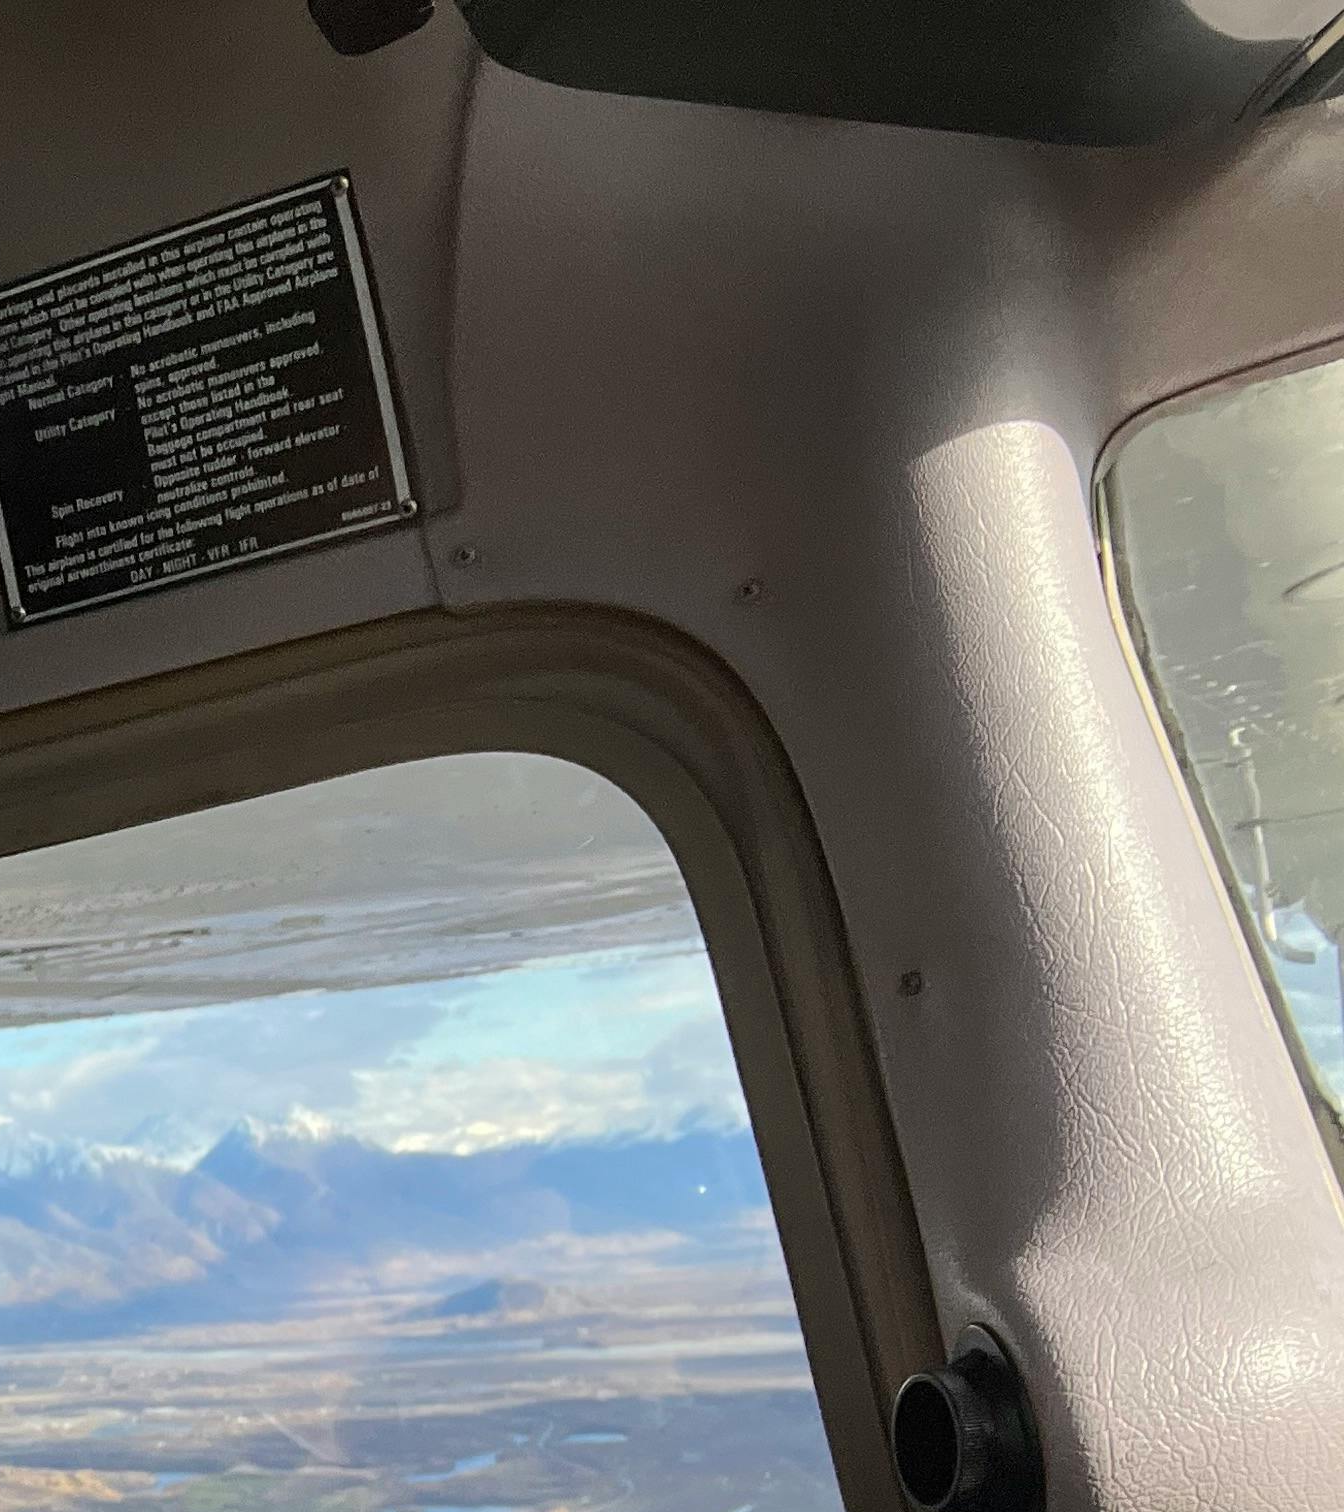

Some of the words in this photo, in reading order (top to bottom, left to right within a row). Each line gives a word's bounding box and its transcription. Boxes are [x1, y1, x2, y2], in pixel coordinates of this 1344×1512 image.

[160, 248, 181, 263] this
[216, 296, 240, 314] FAA
[130, 364, 146, 378] No
[136, 396, 153, 409] No
[156, 380, 204, 403] acrobatic
[207, 361, 266, 387] maneuvers
[67, 376, 113, 398] Category
[210, 383, 241, 403] listed
[243, 382, 255, 394] in
[256, 375, 275, 389] the
[69, 409, 115, 431] Category
[180, 406, 233, 430] Operating
[196, 411, 266, 442] compartment
[270, 402, 291, 420] and
[150, 455, 177, 472] must
[179, 448, 198, 464] not
[199, 445, 214, 458] be
[154, 466, 200, 488] Opposite
[203, 455, 237, 473] rudder
[247, 436, 292, 459] forward
[294, 425, 340, 446] elevator
[51, 505, 74, 518] Spin
[76, 490, 123, 511] Recovery
[48, 553, 85, 572] airplane
[87, 550, 96, 560] is
[98, 535, 138, 557] certified
[140, 532, 154, 545] for
[157, 527, 174, 540] the
[176, 513, 223, 534] following
[254, 489, 309, 513] operations
[311, 484, 325, 496] as
[326, 477, 338, 492] of
[341, 473, 365, 488] date
[368, 465, 379, 480] of
[55, 532, 84, 548] Flight
[146, 507, 172, 521] icing
[174, 490, 228, 514] conditions
[130, 566, 152, 582] DAY
[162, 553, 196, 573] NIGHT
